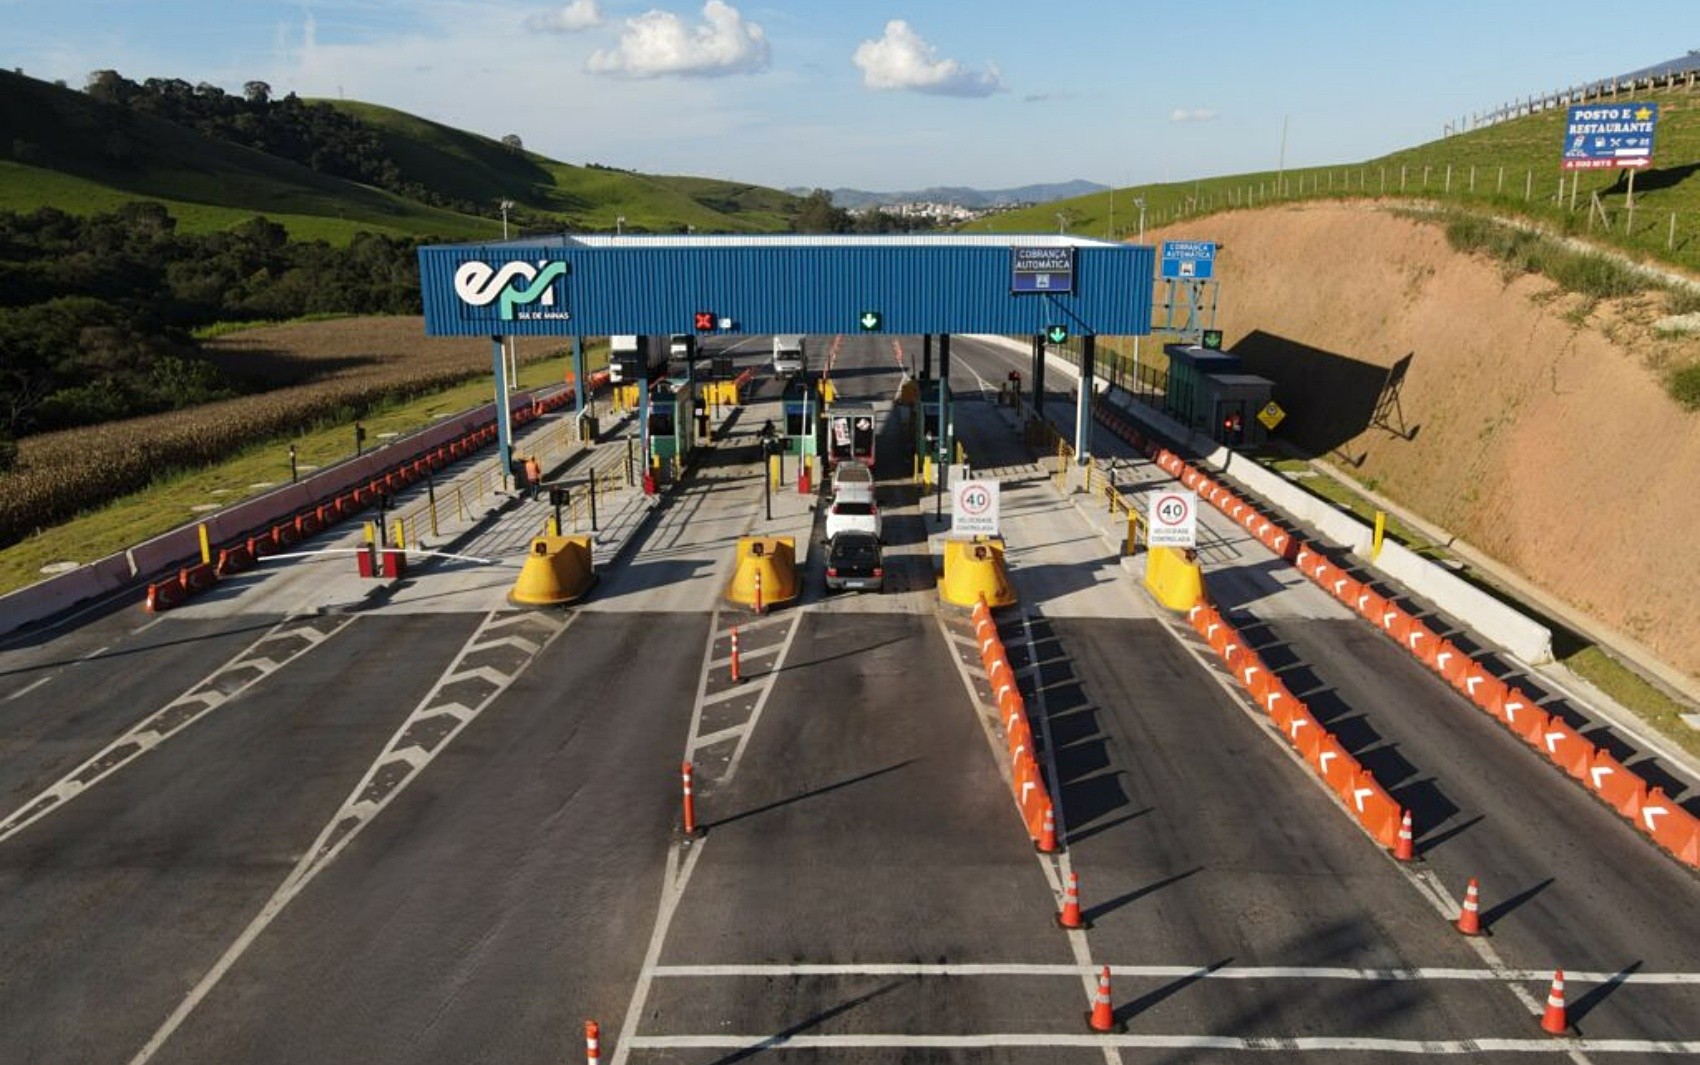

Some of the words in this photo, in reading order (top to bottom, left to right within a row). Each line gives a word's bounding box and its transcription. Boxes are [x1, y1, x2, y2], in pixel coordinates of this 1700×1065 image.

[1575, 108, 1619, 120] POSTO
[1622, 108, 1631, 119] E
[1569, 122, 1653, 134] RESTAURANTE
[1020, 249, 1067, 260] COBRANÇA
[1016, 259, 1070, 269] AUTOMÁTICA
[518, 311, 531, 320] SUL
[532, 311, 542, 320] DE
[544, 311, 570, 320] MINAS
[966, 493, 985, 506] 40
[1161, 504, 1183, 517] 40
